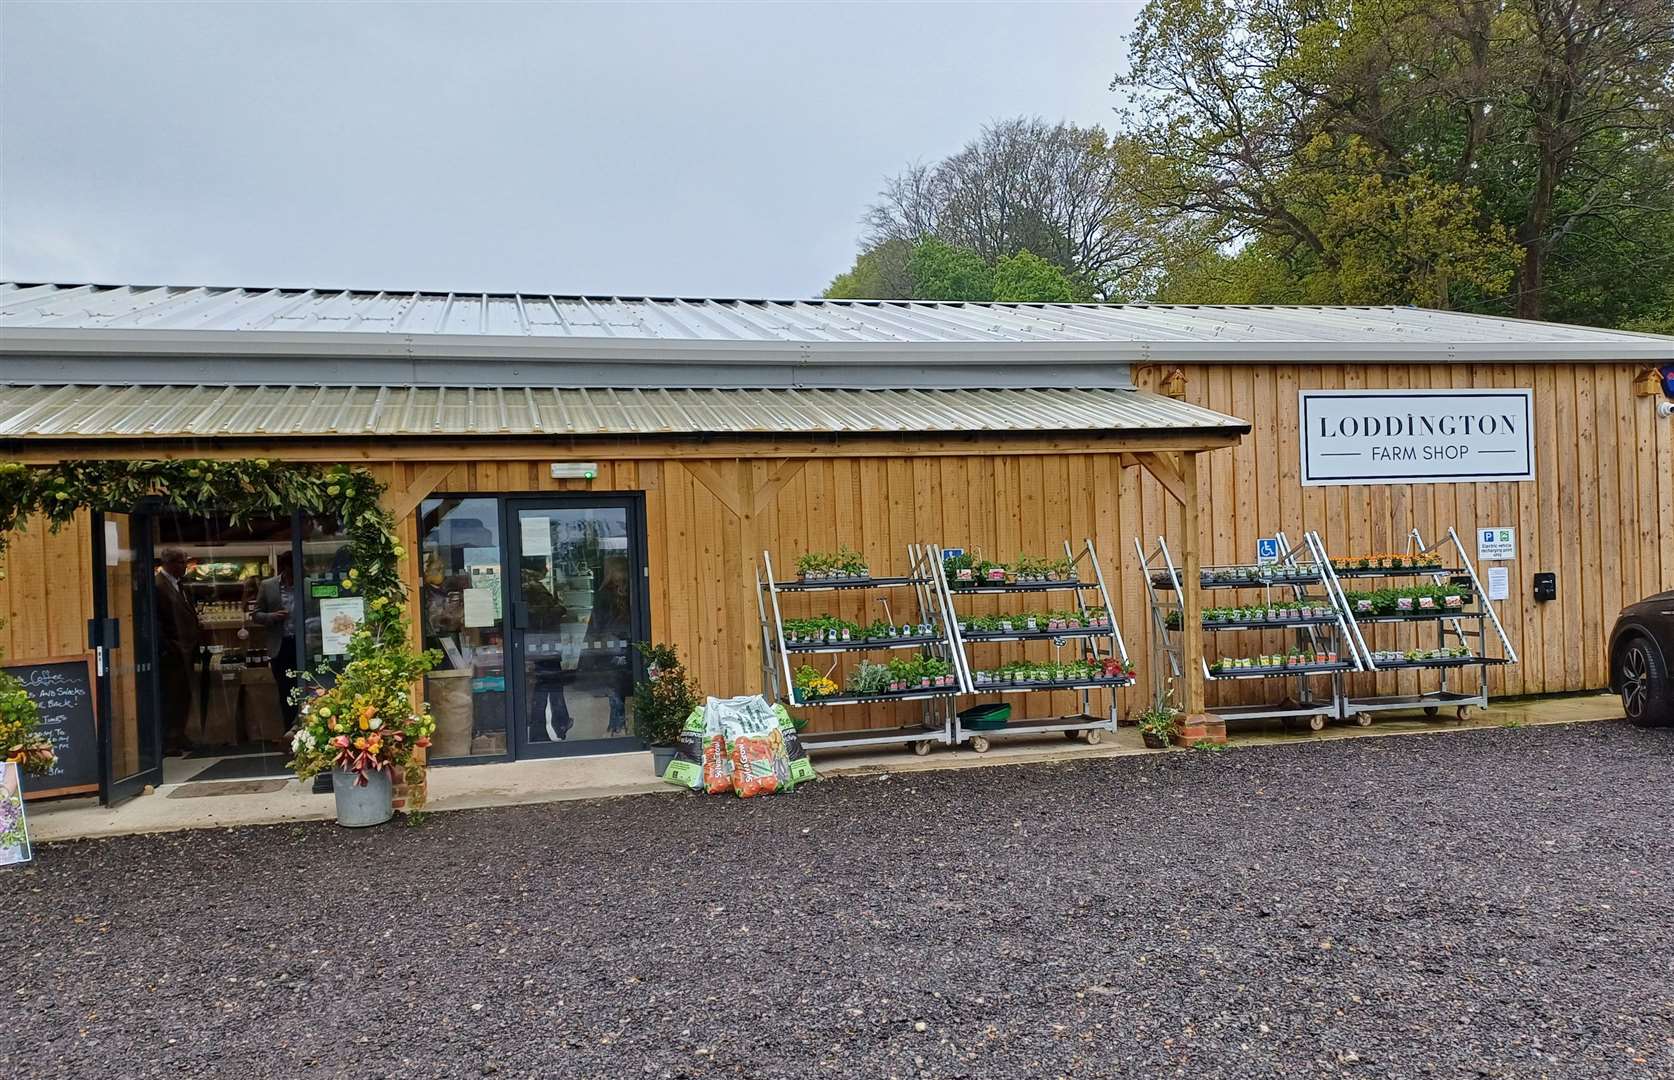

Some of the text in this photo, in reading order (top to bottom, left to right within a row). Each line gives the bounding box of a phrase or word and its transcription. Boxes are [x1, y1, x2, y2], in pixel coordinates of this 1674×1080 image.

[1319, 414, 1517, 438] LODDINGTON
[1371, 445, 1469, 461] FARM SHOP
[30, 670, 65, 686] Coffee
[39, 689, 56, 698] AND
